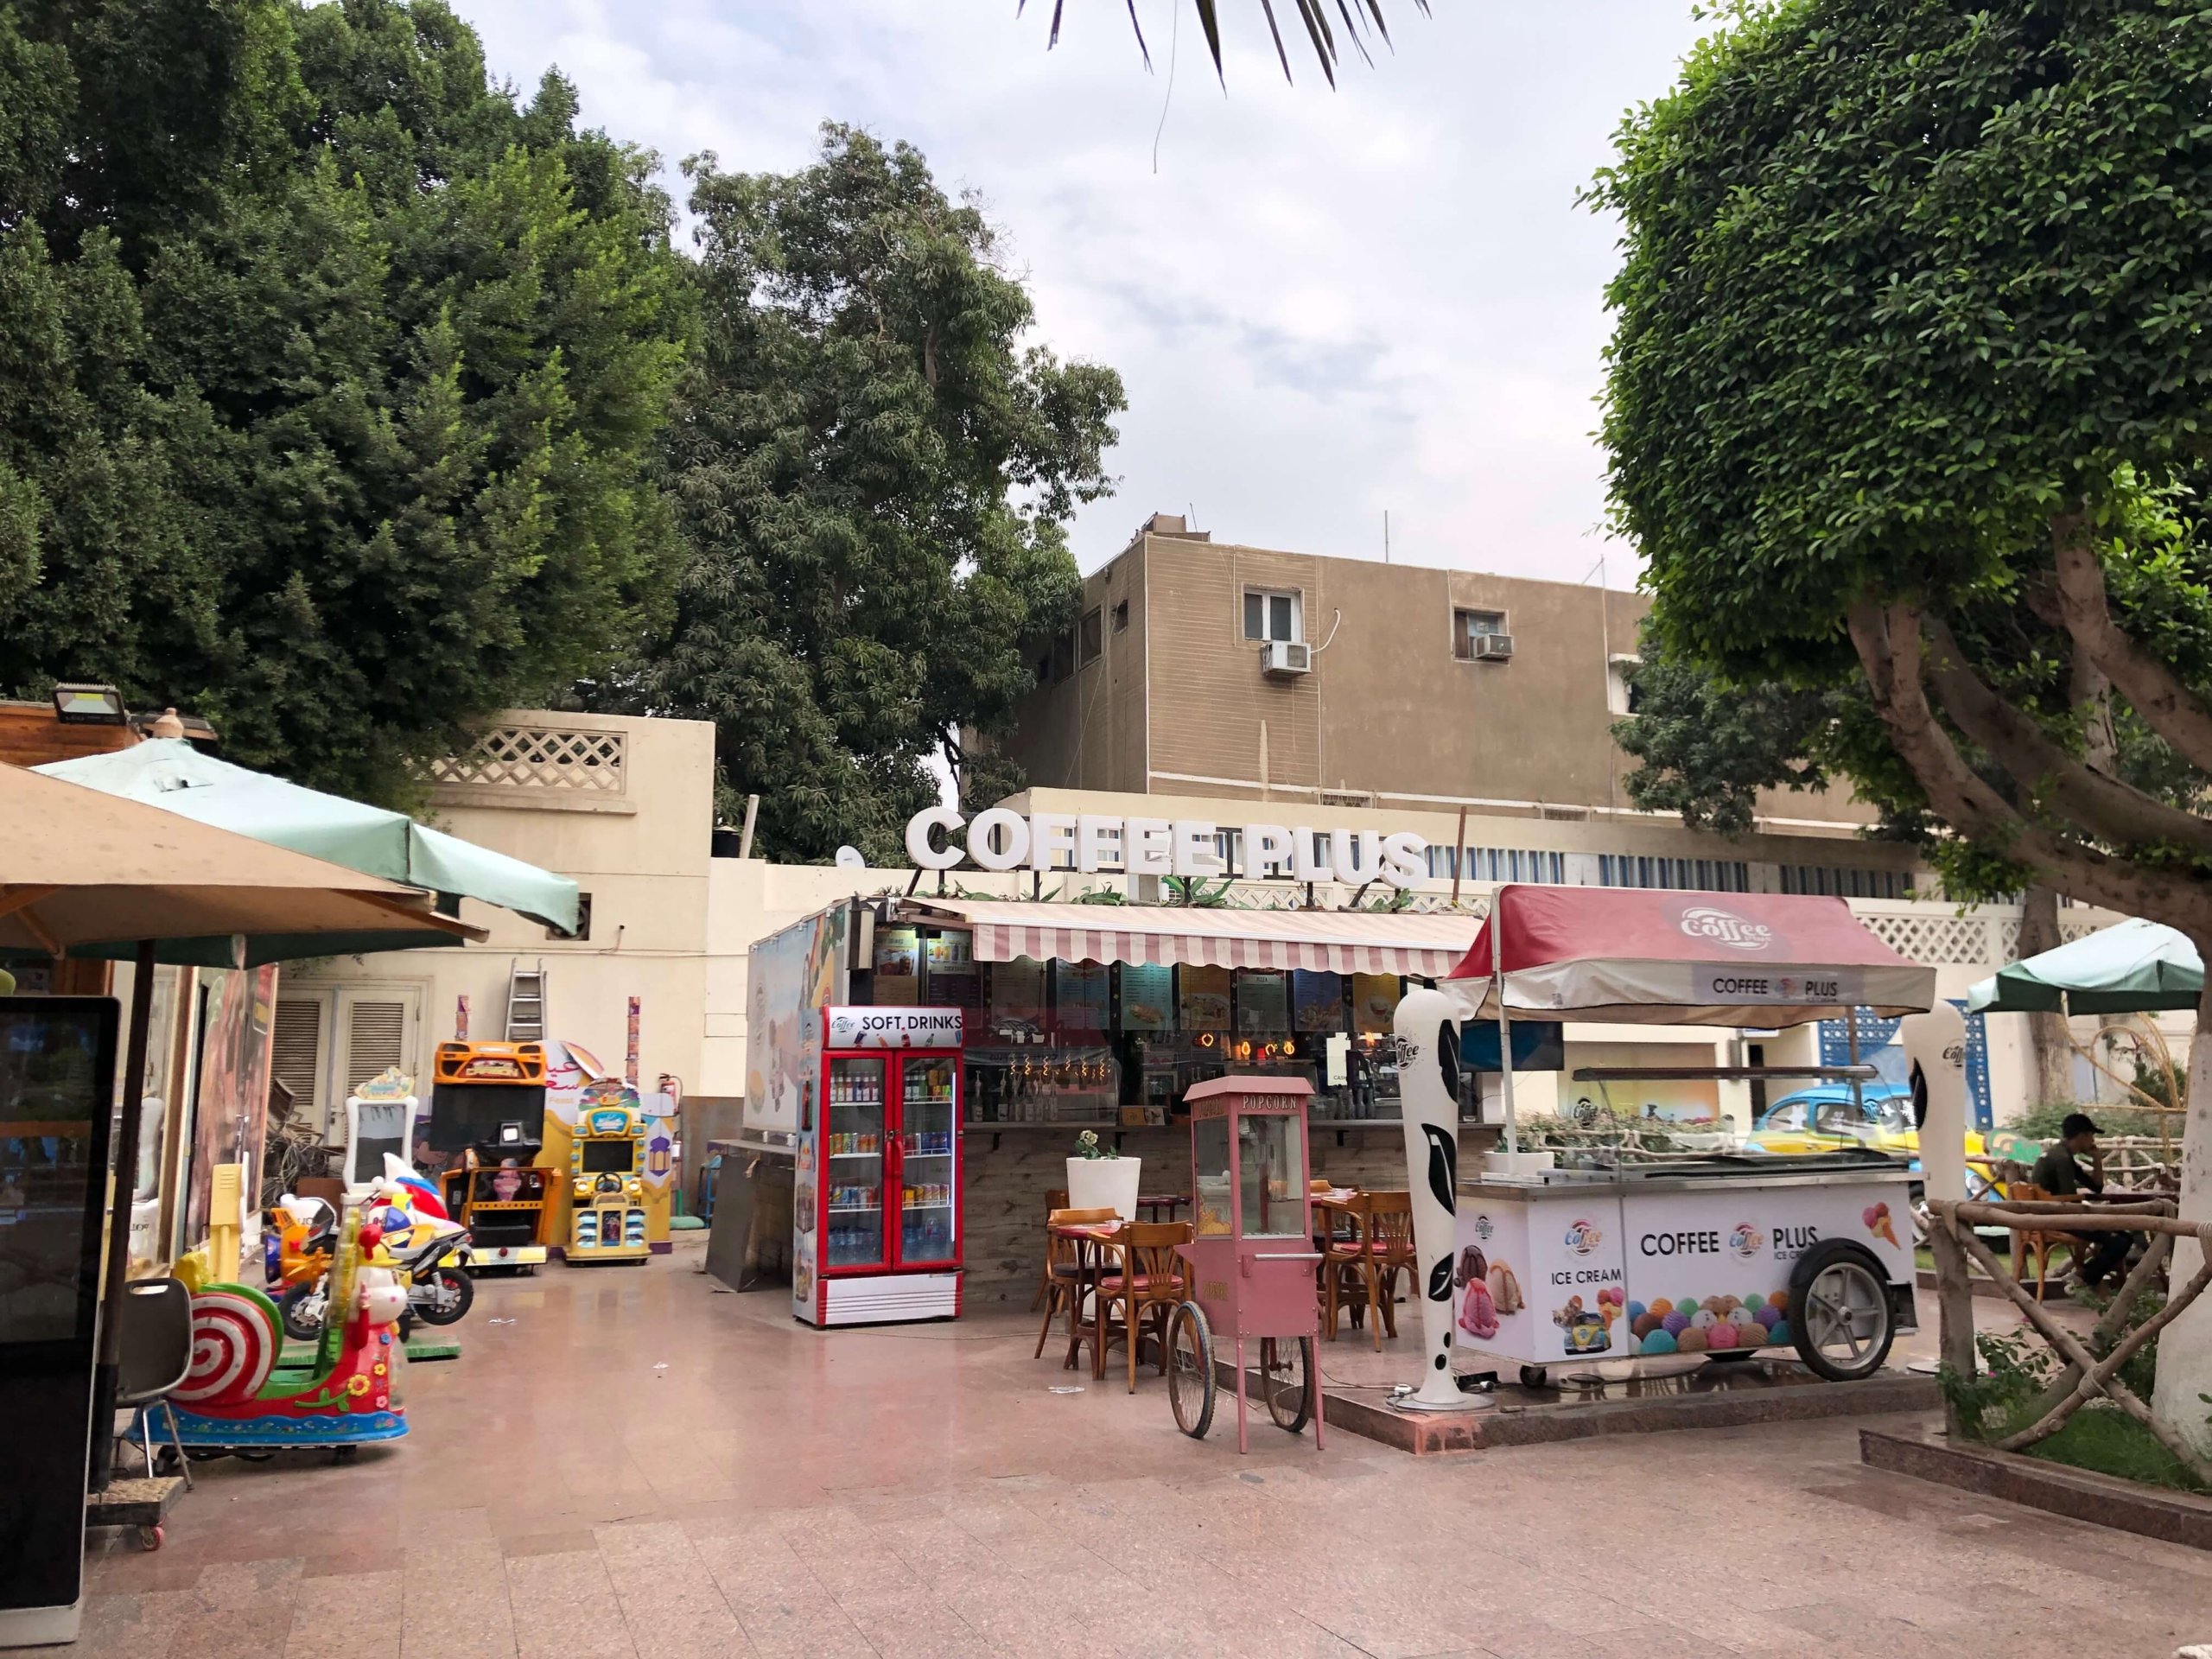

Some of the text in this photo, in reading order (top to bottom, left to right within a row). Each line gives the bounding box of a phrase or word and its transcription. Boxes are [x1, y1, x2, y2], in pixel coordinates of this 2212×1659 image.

[906, 806, 1429, 889] COFFEE PLUS
[1681, 916, 1772, 942] Coffee
[1713, 977, 1769, 995] COFFEE
[1805, 981, 1838, 996] PLUS
[862, 1015, 963, 1030] SOFT DRINKS
[1396, 1042, 1420, 1063] ffee
[1243, 1095, 1297, 1109] POPCORN
[1565, 1227, 1603, 1249] Coffee
[1641, 1226, 1818, 1256] COFFEE PLUS
[1729, 1230, 1764, 1250] Coffee
[1774, 1251, 1787, 1260] ICE
[1552, 1268, 1622, 1285] ICE CREAM
